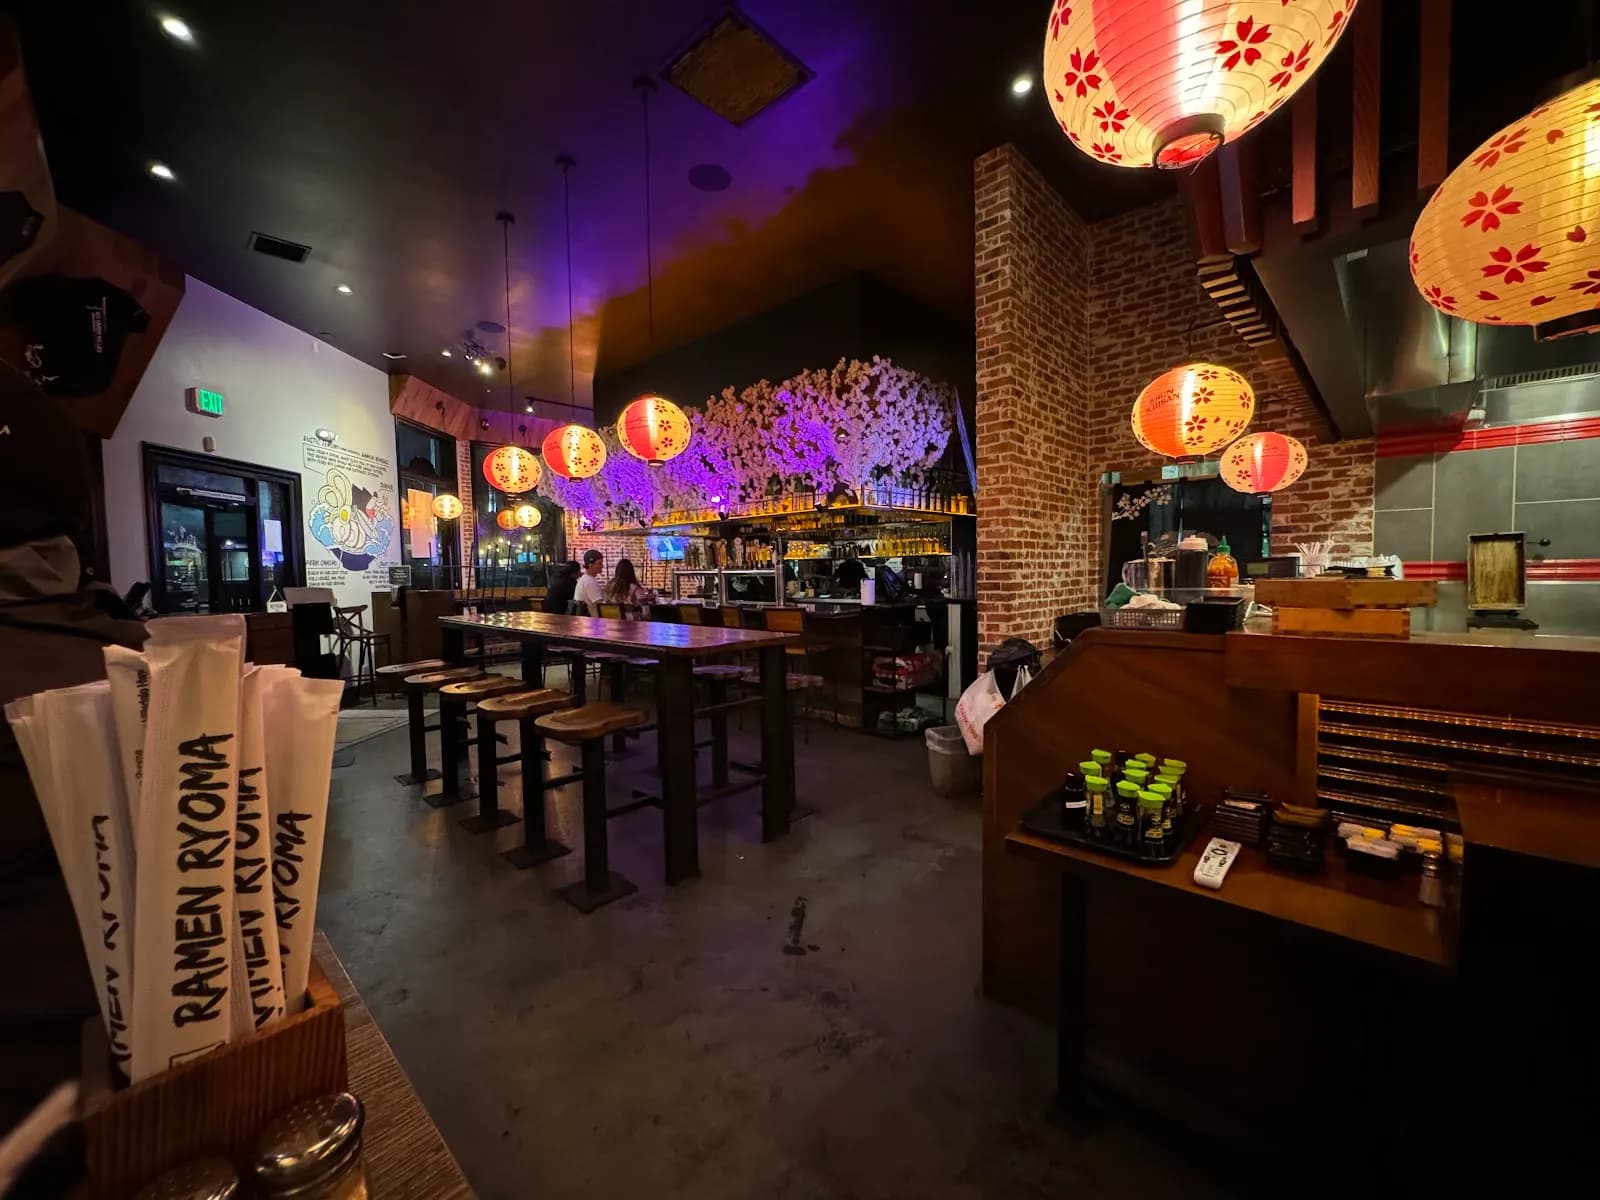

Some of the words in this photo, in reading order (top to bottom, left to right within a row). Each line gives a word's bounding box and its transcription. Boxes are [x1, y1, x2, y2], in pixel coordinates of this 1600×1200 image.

[199, 389, 224, 415] EXIT
[175, 732, 234, 873] RYOMA
[271, 810, 313, 930] RYOMA
[170, 885, 229, 1029] RAMEN
